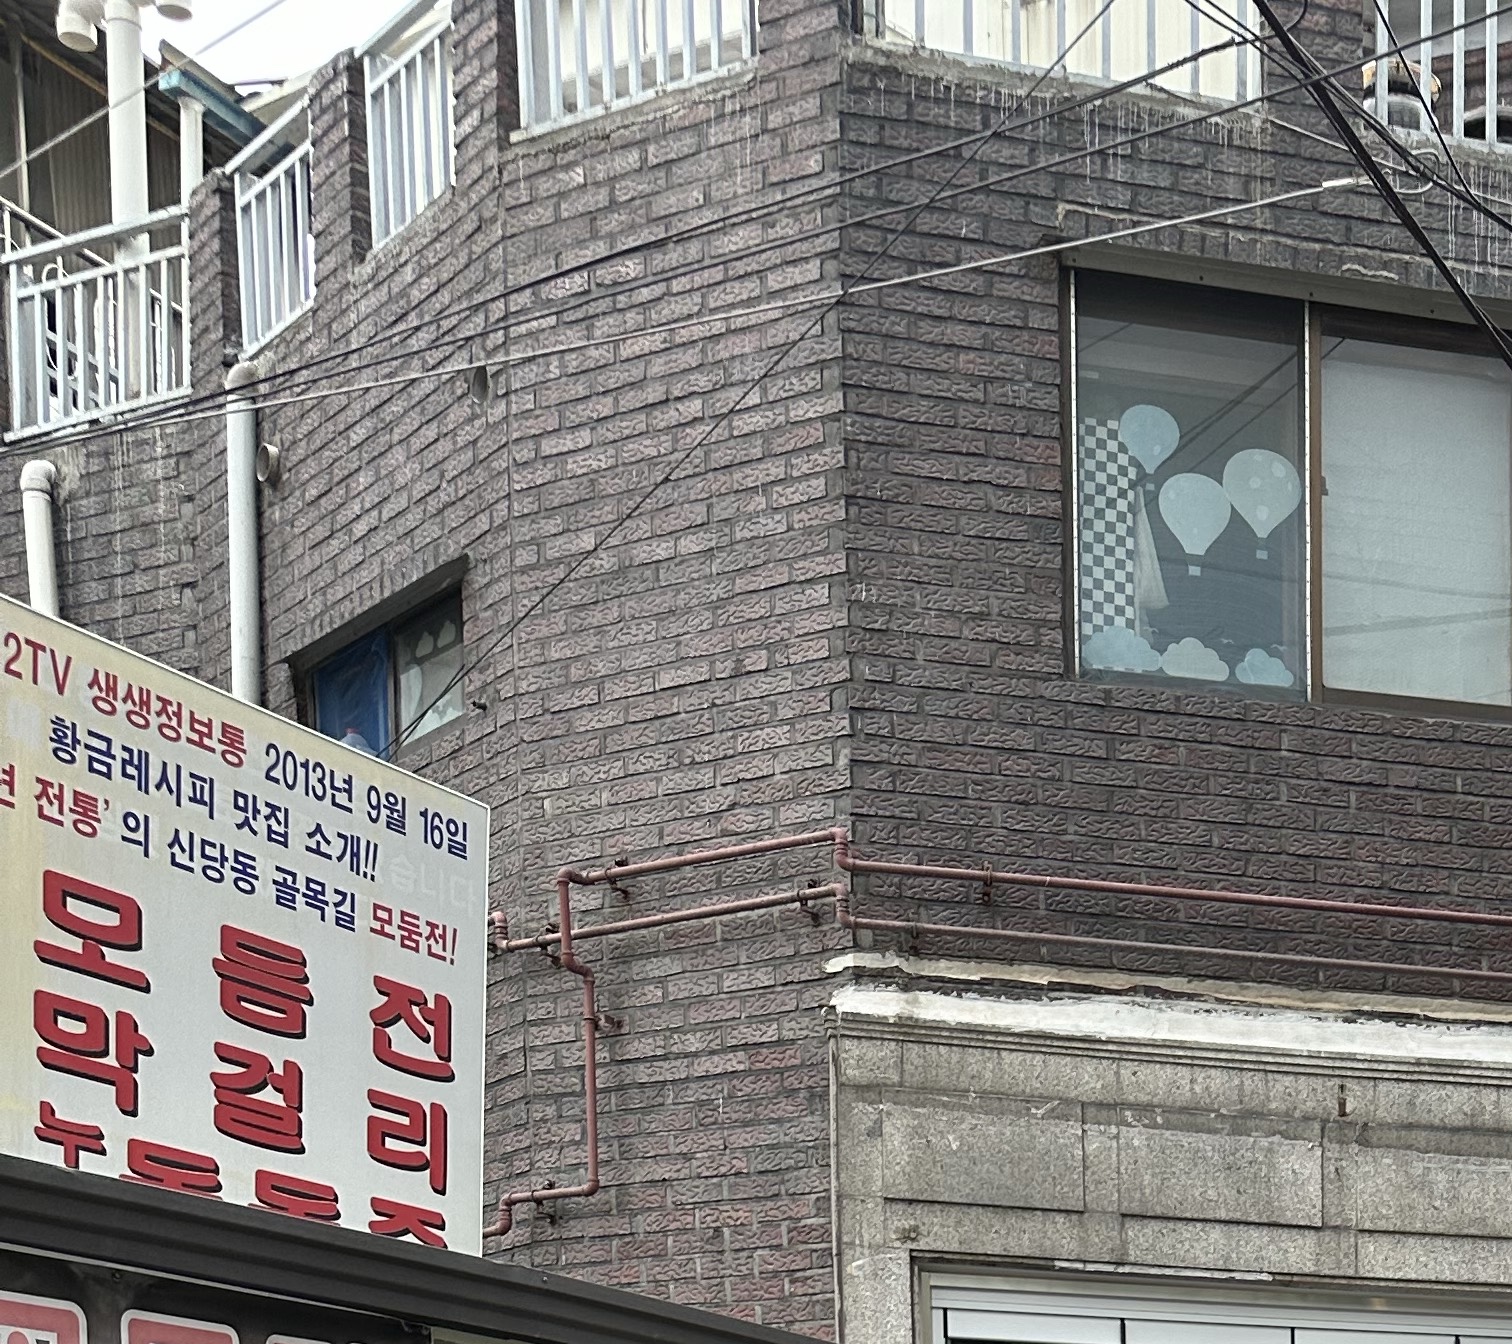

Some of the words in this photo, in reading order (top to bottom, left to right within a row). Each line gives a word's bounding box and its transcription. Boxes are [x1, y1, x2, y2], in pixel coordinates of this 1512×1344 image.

[3, 631, 73, 697] 2TV
[87, 667, 248, 769] 생생정보통
[265, 742, 353, 815] 2013년
[366, 784, 407, 837] 9월
[419, 806, 468, 861] 16일
[49, 714, 215, 821] 황금레시피
[233, 788, 290, 850] 맛집
[305, 821, 378, 883] 소개!!
[167, 827, 260, 896] 신당동
[272, 864, 357, 933] 골목길
[369, 901, 458, 967] 모둠전!
